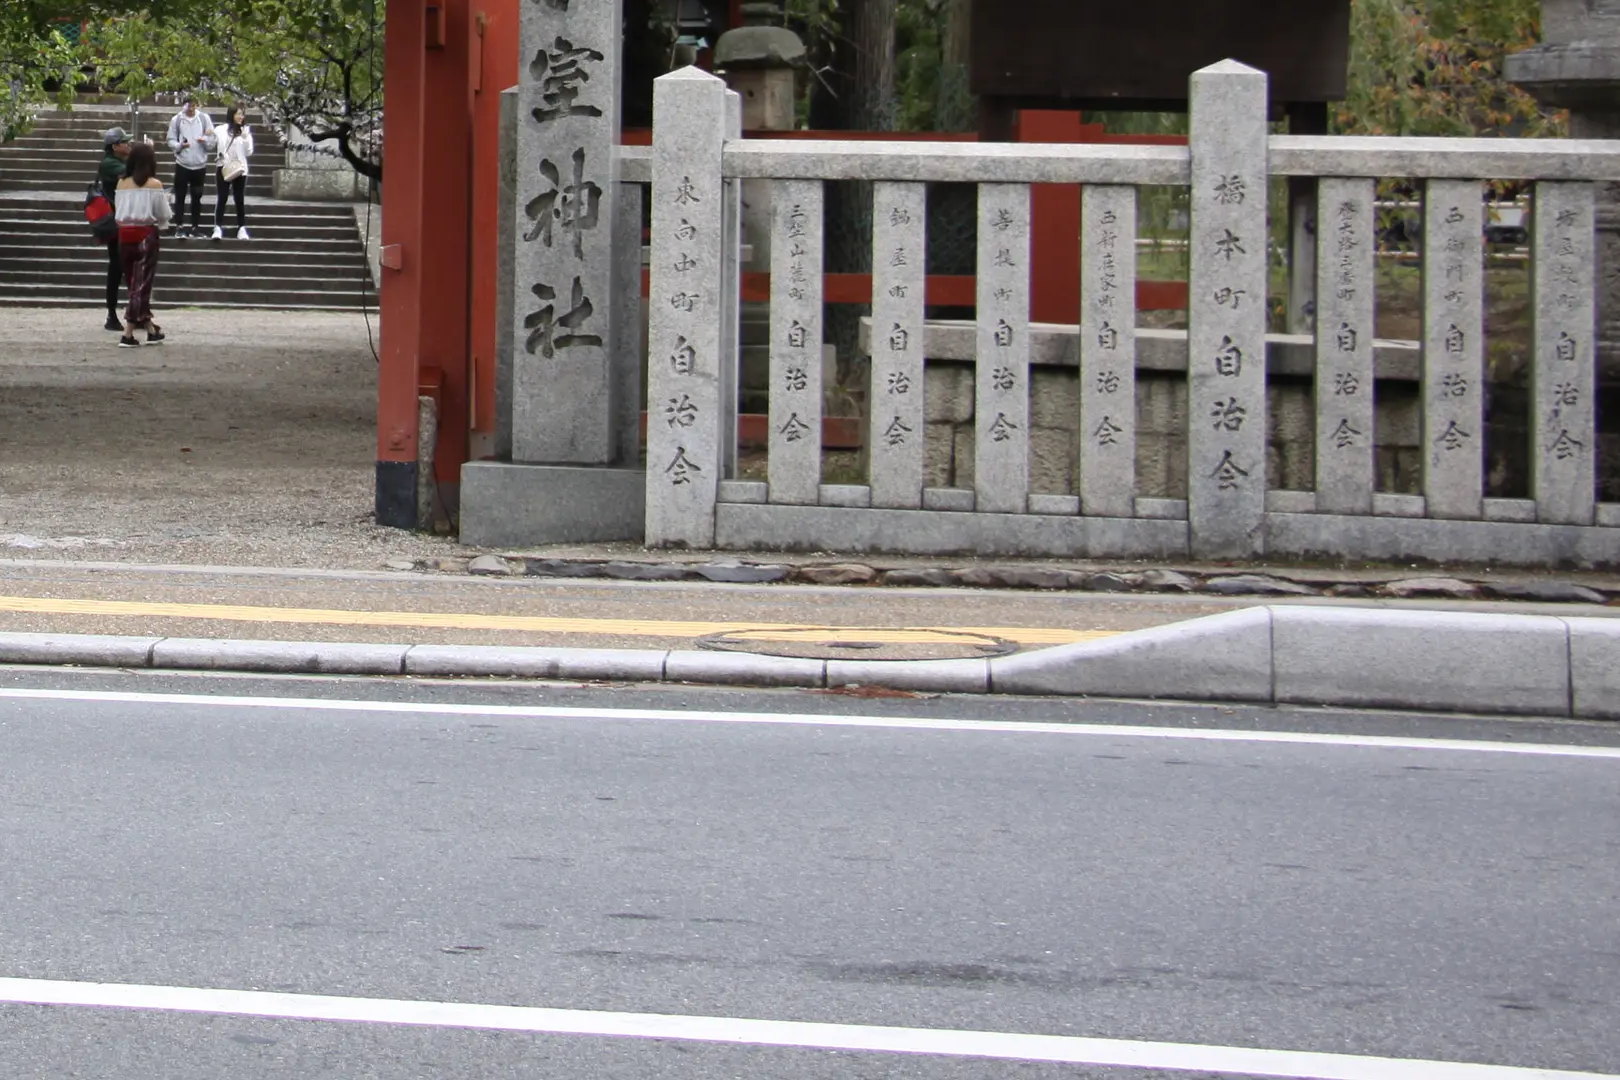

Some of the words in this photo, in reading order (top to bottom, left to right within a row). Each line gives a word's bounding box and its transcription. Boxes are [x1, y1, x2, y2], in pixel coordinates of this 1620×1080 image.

[1209, 175, 1248, 490] 橋本町自治会
